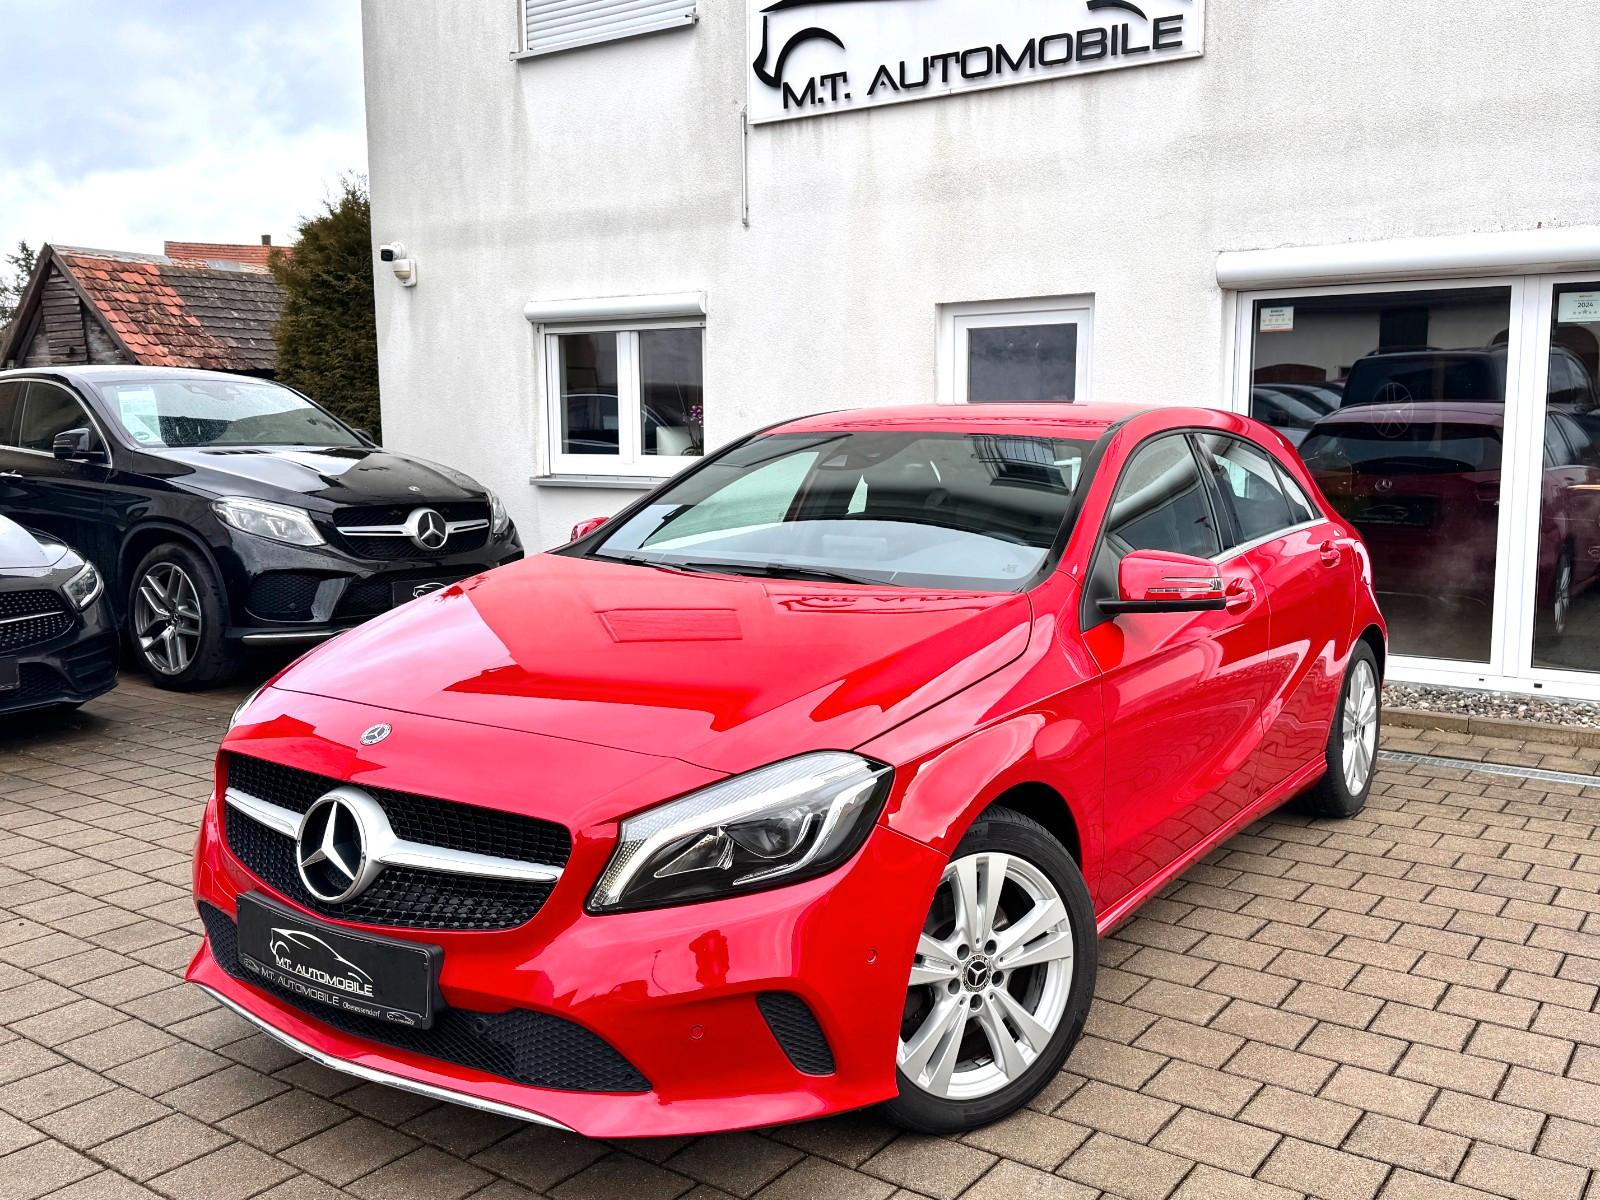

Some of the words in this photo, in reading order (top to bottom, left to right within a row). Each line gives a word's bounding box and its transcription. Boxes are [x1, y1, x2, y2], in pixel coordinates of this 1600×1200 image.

[782, 72, 851, 110] M.T.
[866, 14, 1184, 96] AUTOMOBILE
[276, 956, 292, 971] M.T.
[295, 963, 374, 996] AUTOMOBILE
[277, 976, 340, 1006] AUTOMOBILE
